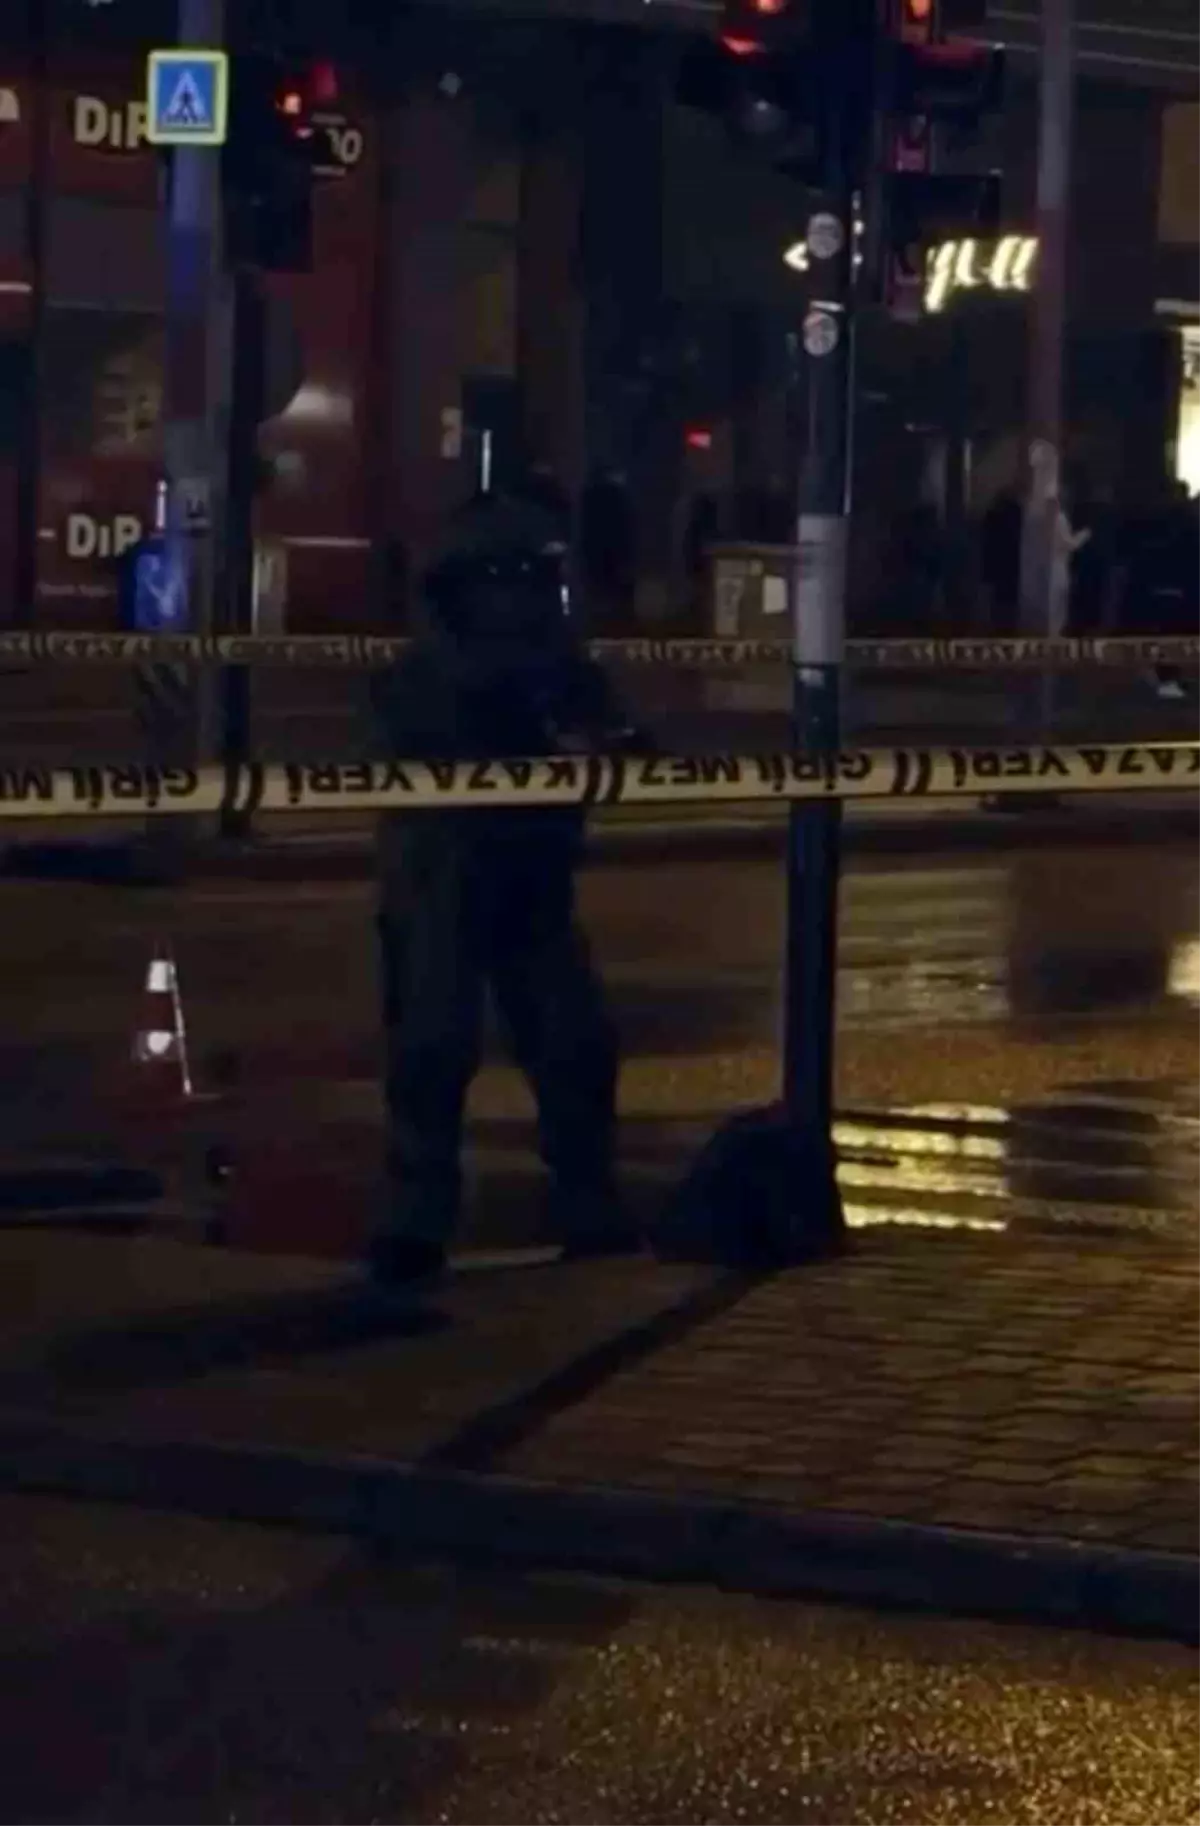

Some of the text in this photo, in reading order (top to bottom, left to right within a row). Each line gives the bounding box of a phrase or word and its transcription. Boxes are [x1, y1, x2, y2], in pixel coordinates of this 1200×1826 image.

[0, 762, 198, 808] GİRİLM
[285, 759, 578, 805] KAZA YERİ
